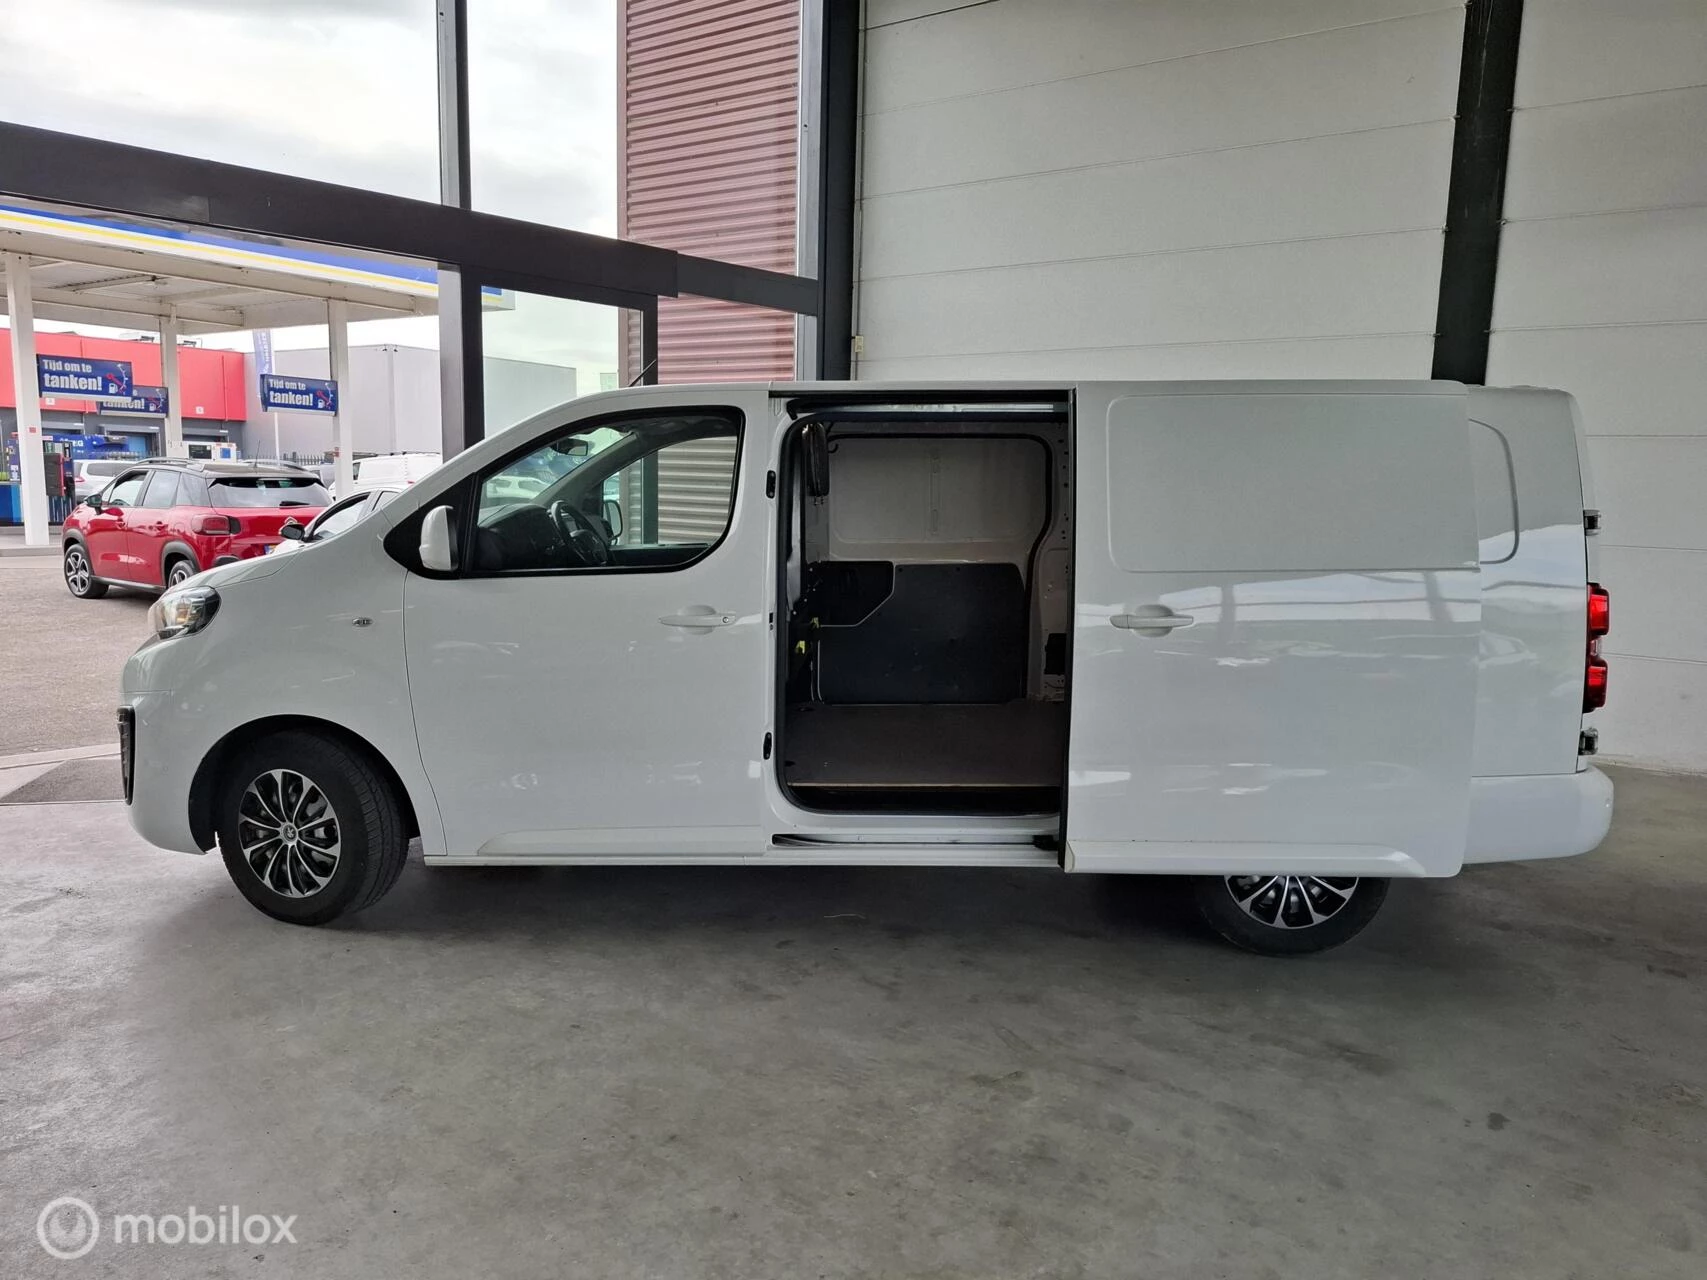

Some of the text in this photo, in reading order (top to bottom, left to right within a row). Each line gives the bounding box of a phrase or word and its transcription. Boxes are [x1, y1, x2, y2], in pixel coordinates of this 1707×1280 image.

[43, 359, 92, 373] Tijd om te
[44, 373, 103, 391] tanken!
[269, 379, 306, 391] Tijd om te
[269, 391, 314, 406] tanken!
